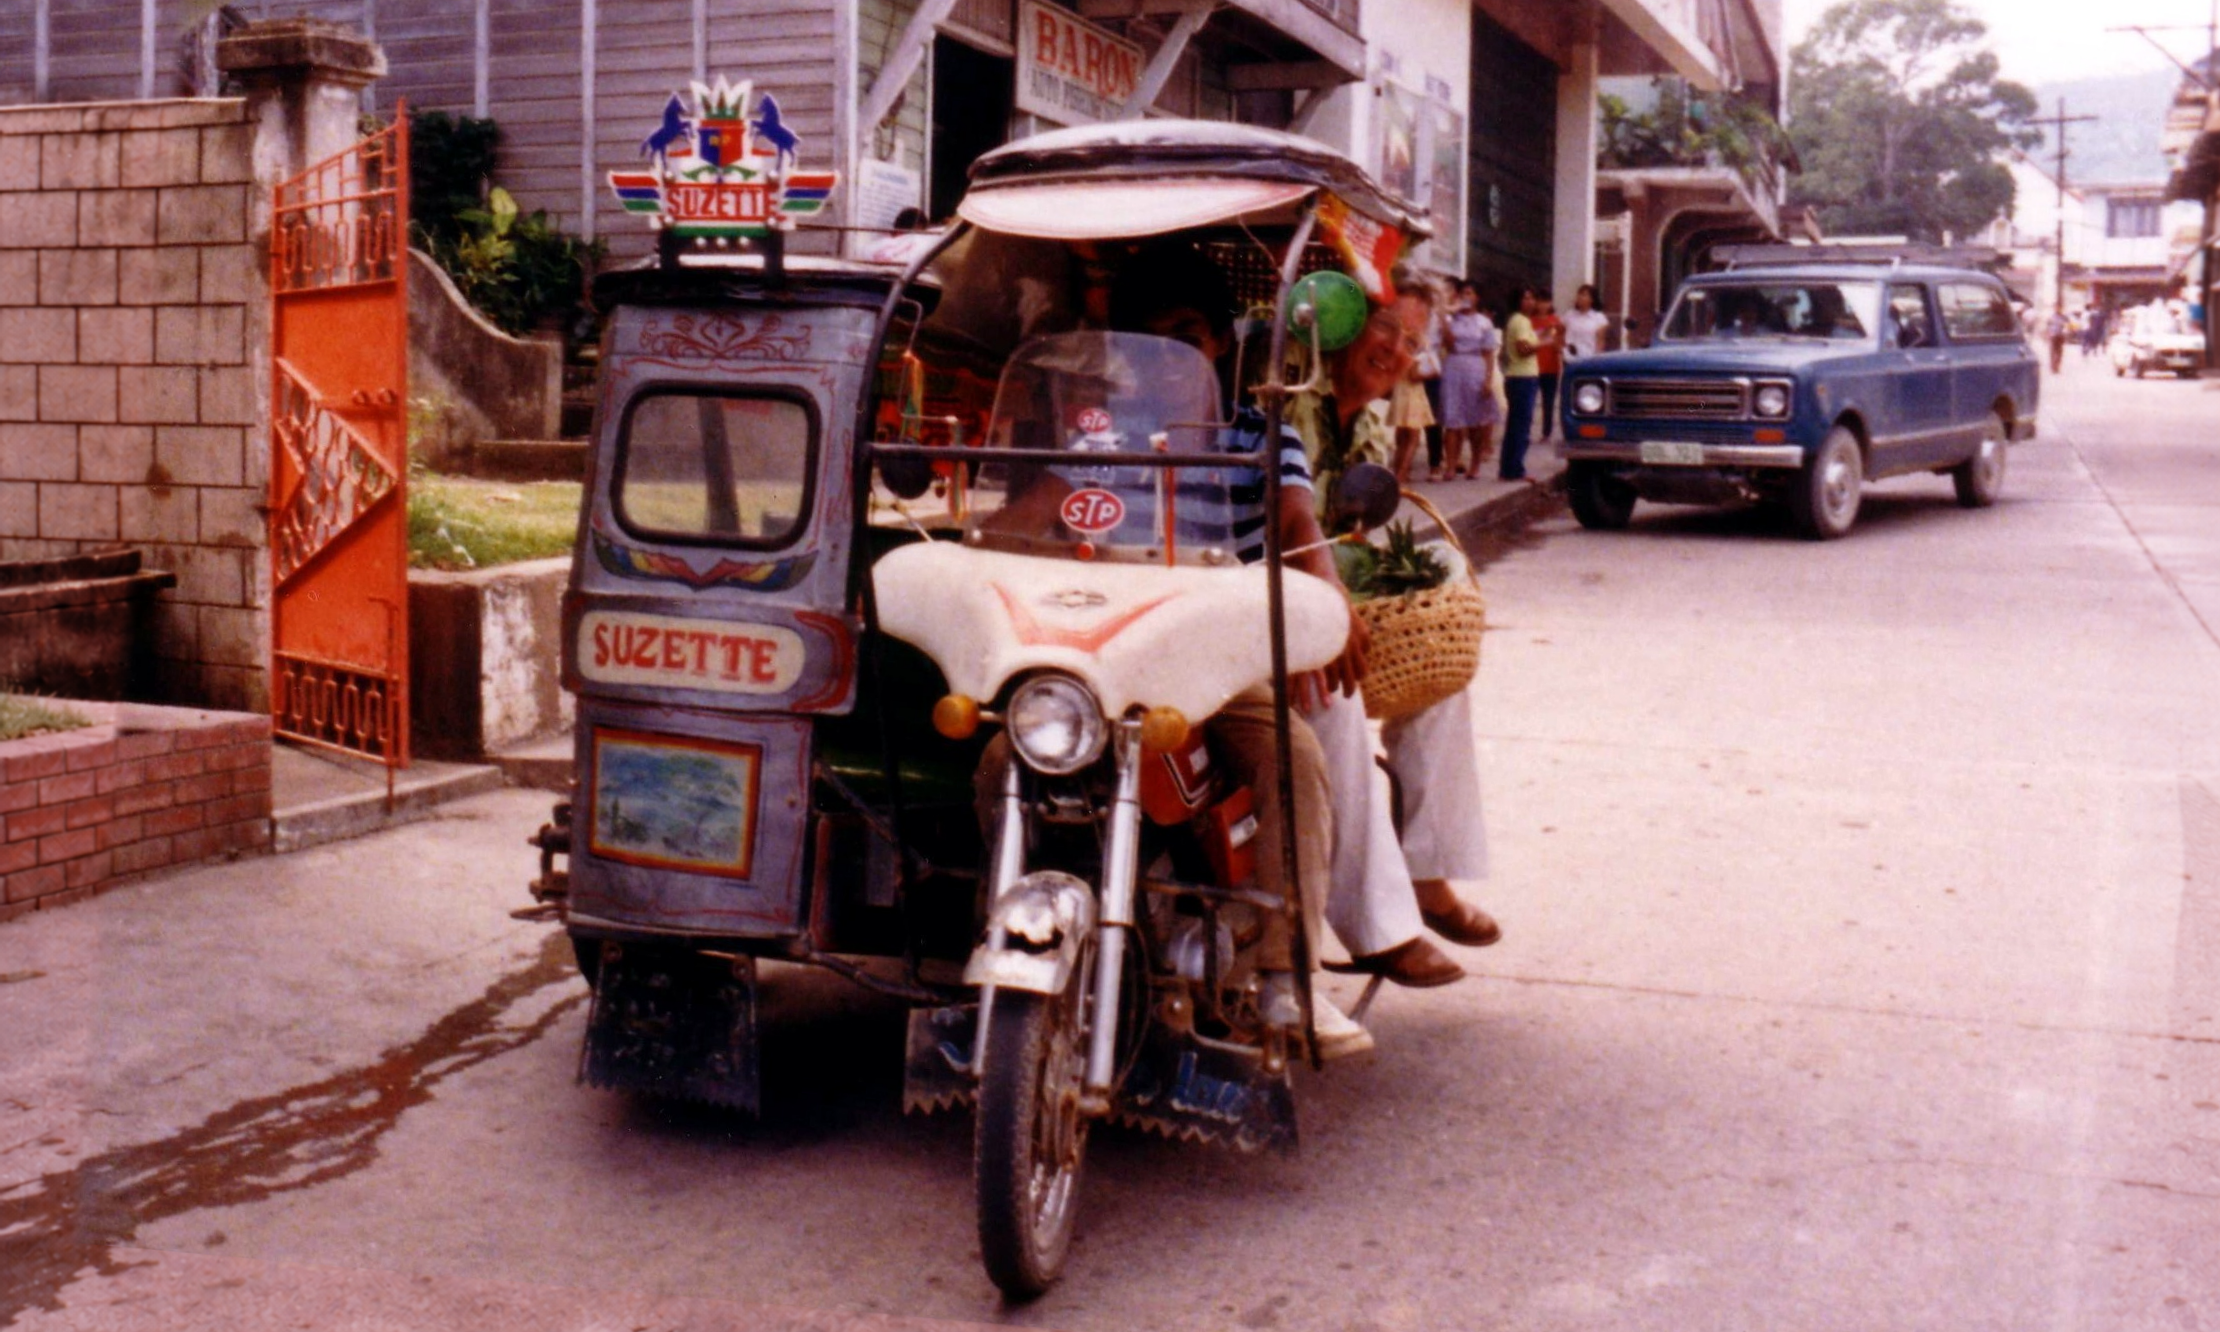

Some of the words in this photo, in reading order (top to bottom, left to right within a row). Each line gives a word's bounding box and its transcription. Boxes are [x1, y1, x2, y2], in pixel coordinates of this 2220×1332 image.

[1036, 9, 1138, 100] BARON
[666, 187, 777, 217] SUZETTE
[1081, 411, 1109, 429] STP
[1068, 495, 1117, 526] STP
[593, 622, 778, 684] SUZETTE
